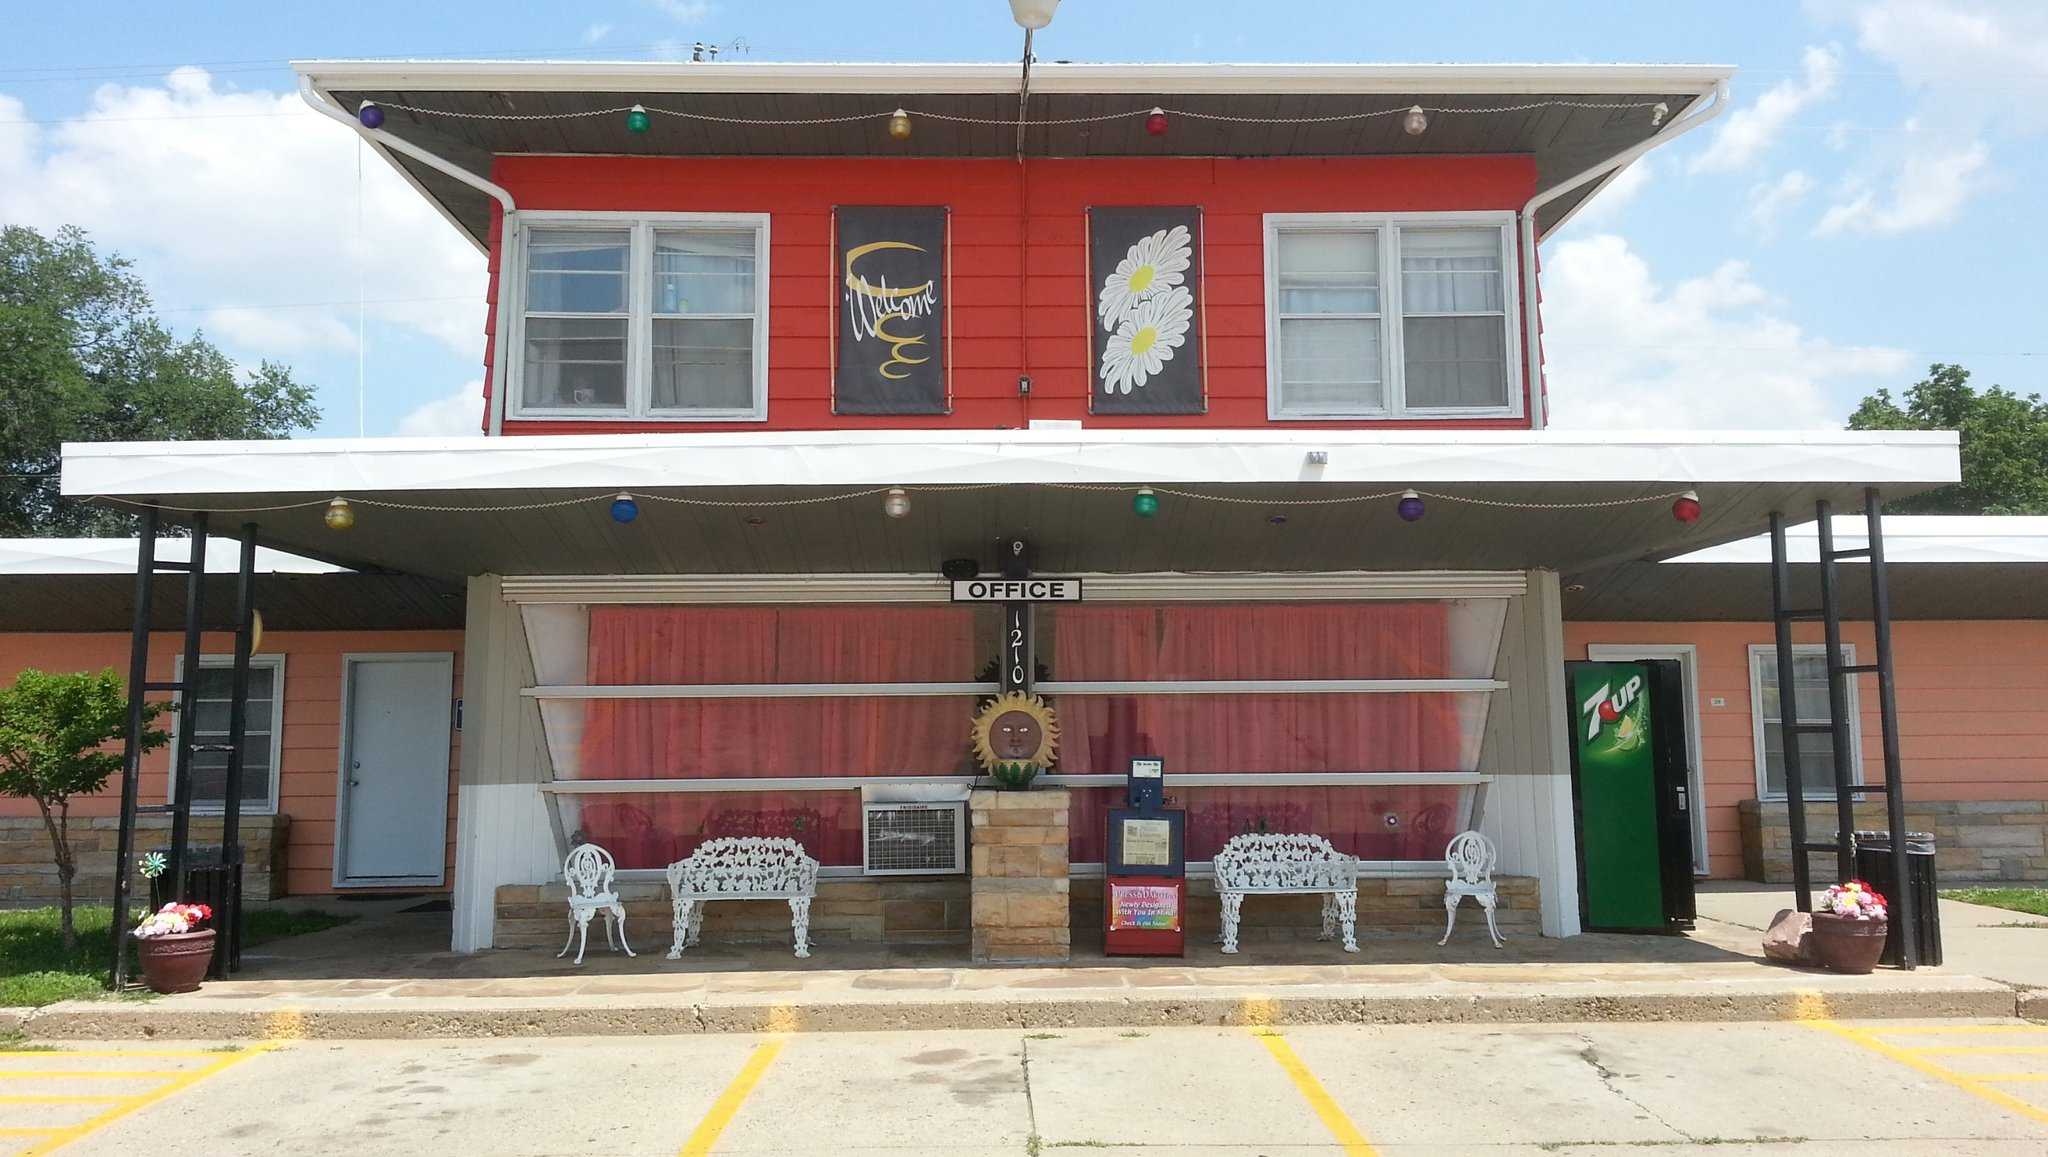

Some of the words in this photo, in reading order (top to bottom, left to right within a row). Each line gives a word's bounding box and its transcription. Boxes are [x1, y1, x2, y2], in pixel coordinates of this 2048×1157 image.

[846, 274, 937, 342] Welcome
[968, 582, 1065, 598] OFFICE
[1011, 610, 1024, 684] 1210
